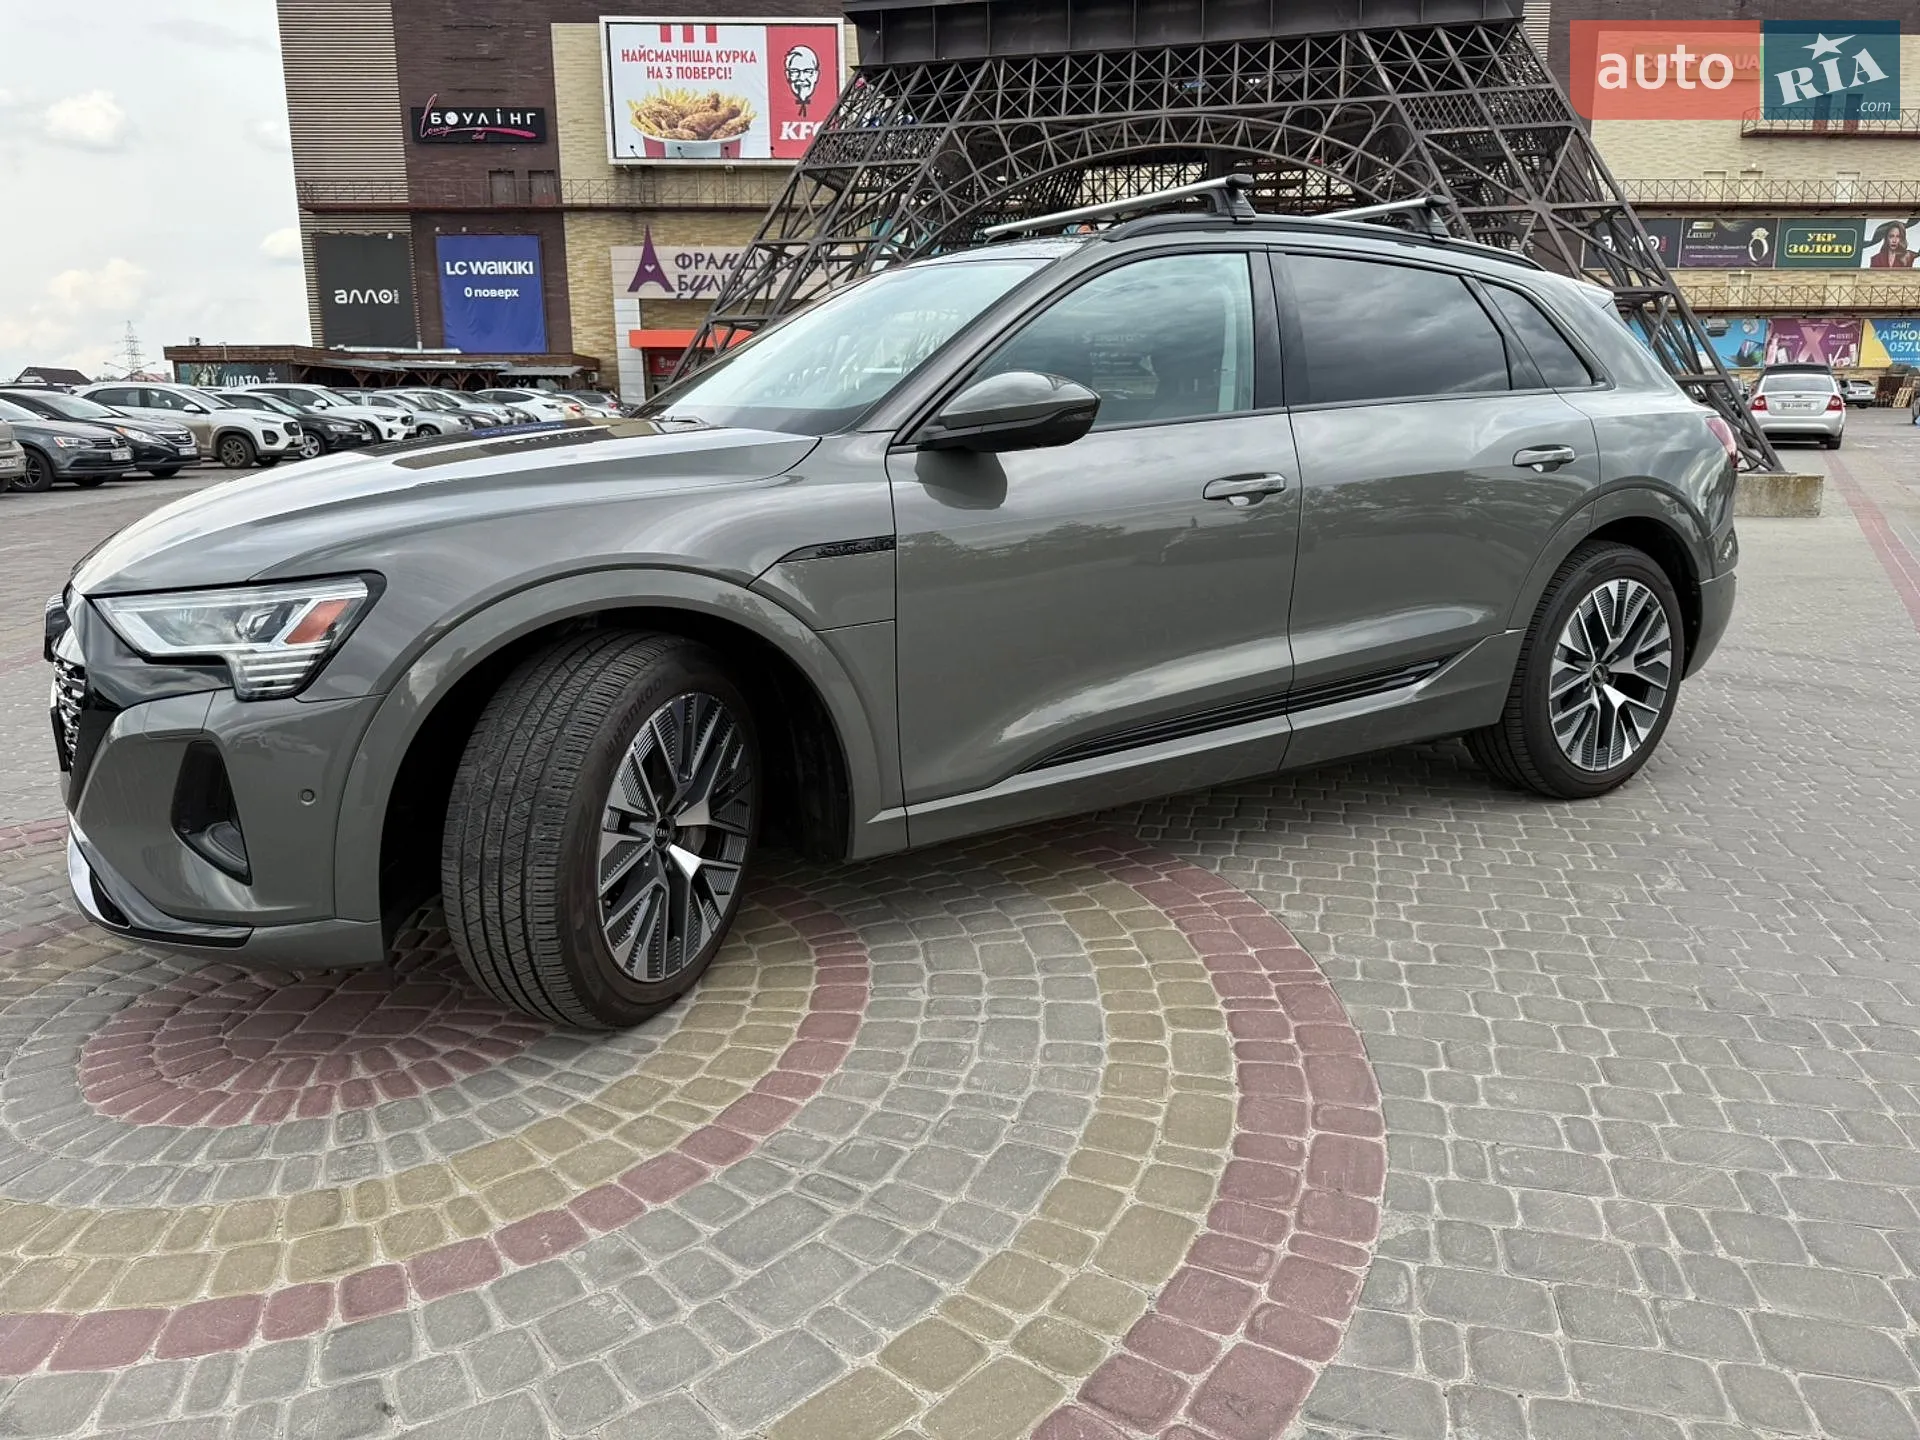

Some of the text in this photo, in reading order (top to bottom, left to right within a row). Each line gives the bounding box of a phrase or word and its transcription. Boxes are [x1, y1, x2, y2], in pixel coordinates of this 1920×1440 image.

[621, 45, 757, 64] НАЙСМАЧНІША КУРКА
[646, 66, 732, 80] НА 3 ПОВЕРСІ!
[430, 108, 536, 125] БОУЛІНГ
[1807, 232, 1837, 242] УКР
[1788, 244, 1853, 254] ЗОЛОТО
[445, 261, 468, 275] LC
[464, 286, 519, 300] 0 поверх
